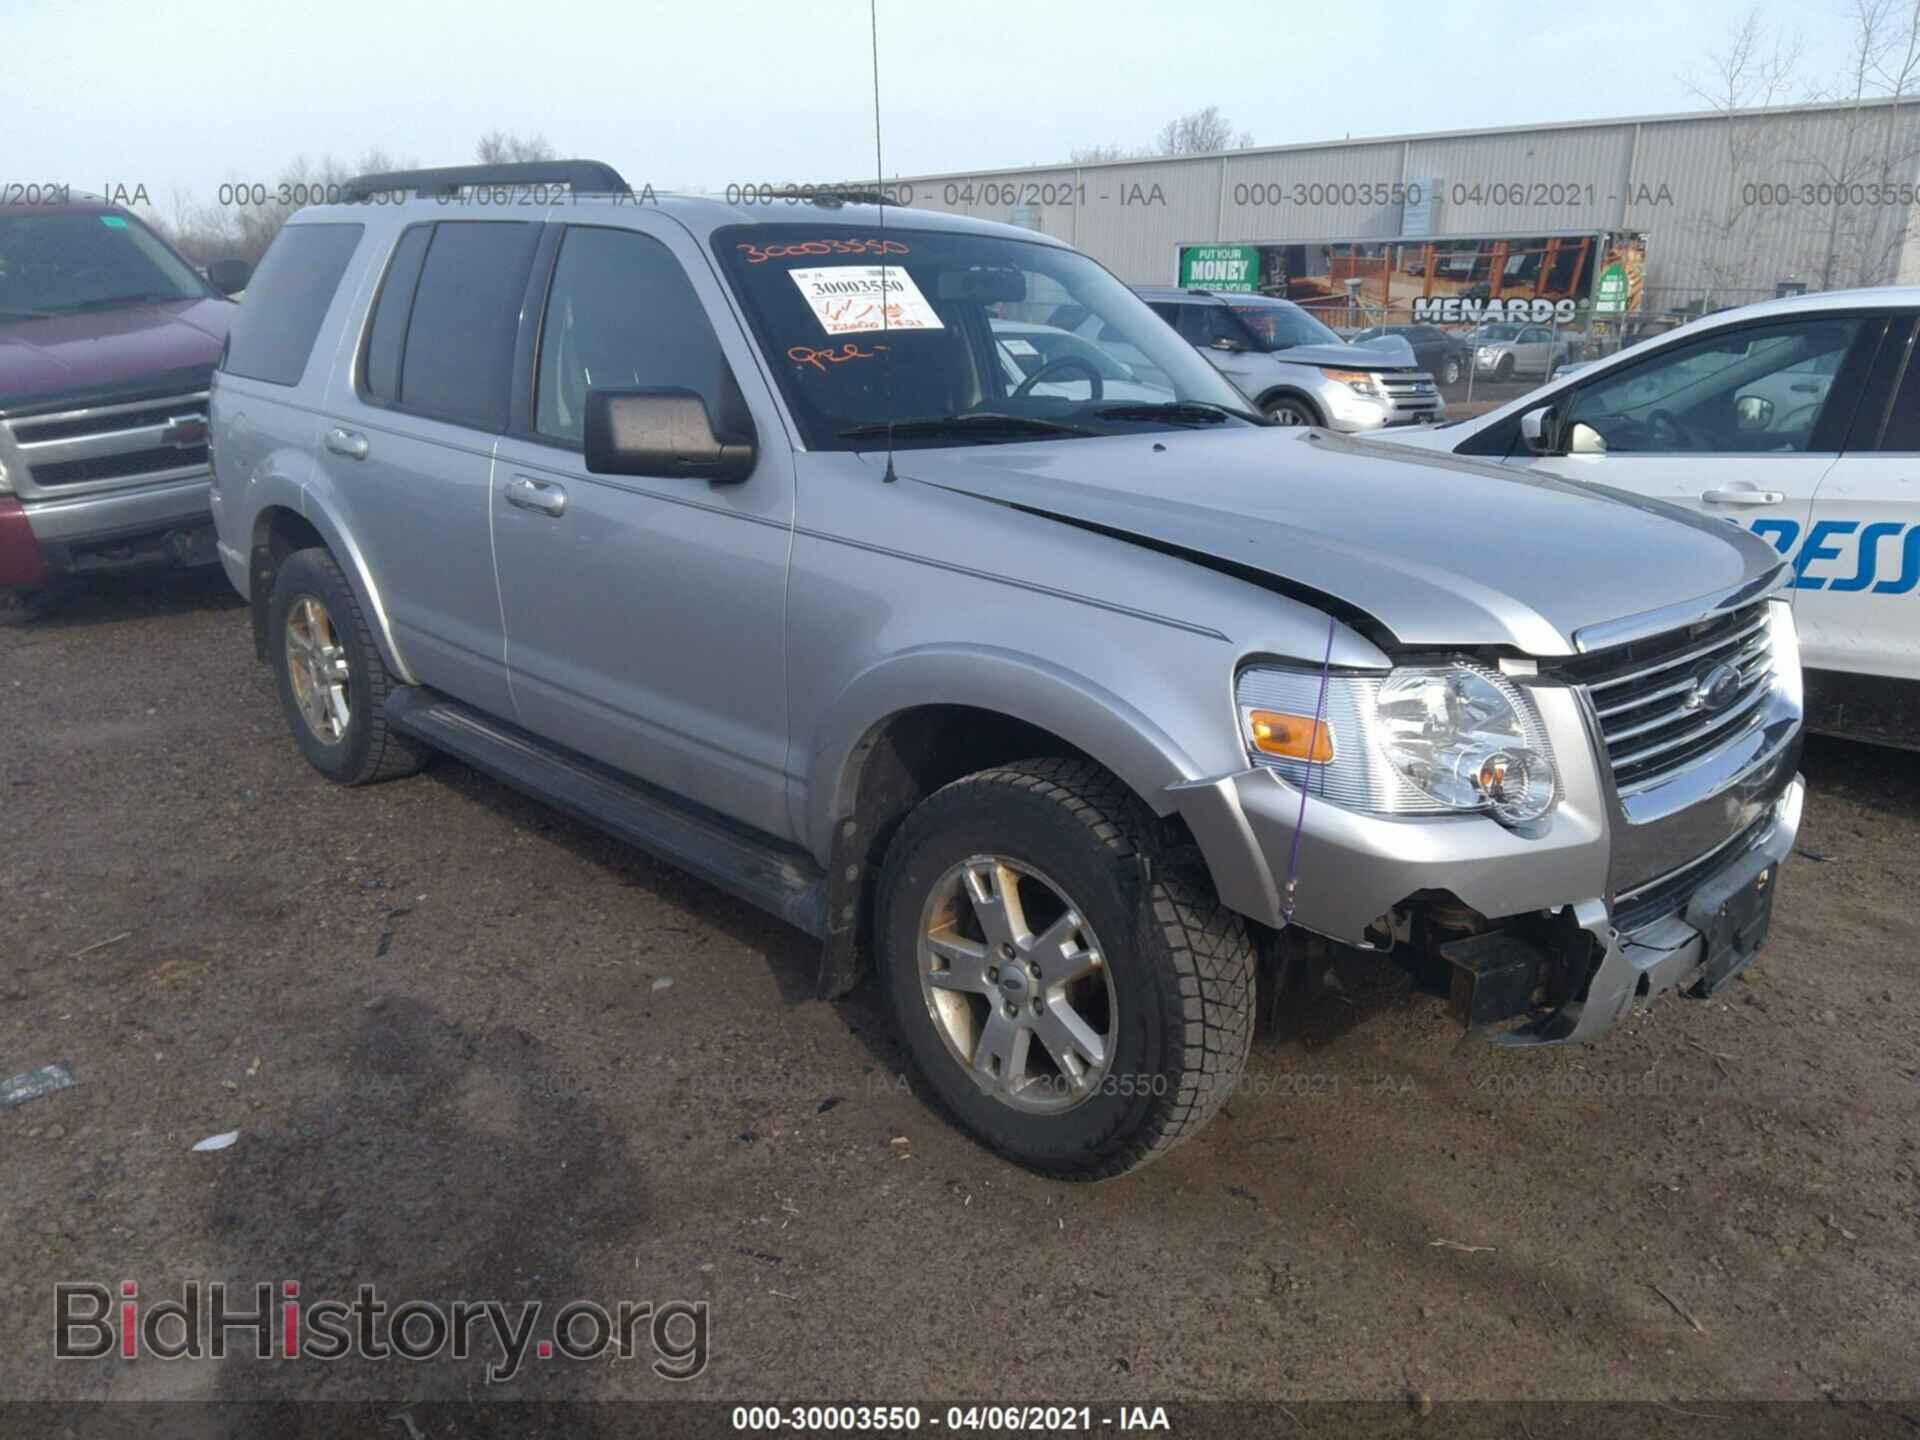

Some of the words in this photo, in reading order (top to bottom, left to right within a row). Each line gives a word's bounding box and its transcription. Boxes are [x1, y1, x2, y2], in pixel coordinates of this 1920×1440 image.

[1200, 249, 1215, 259] PUT
[1216, 249, 1241, 258] YOUR
[1191, 260, 1248, 281] MONEY
[811, 279, 904, 297] 30003550
[1413, 297, 1577, 323] MENARDS
